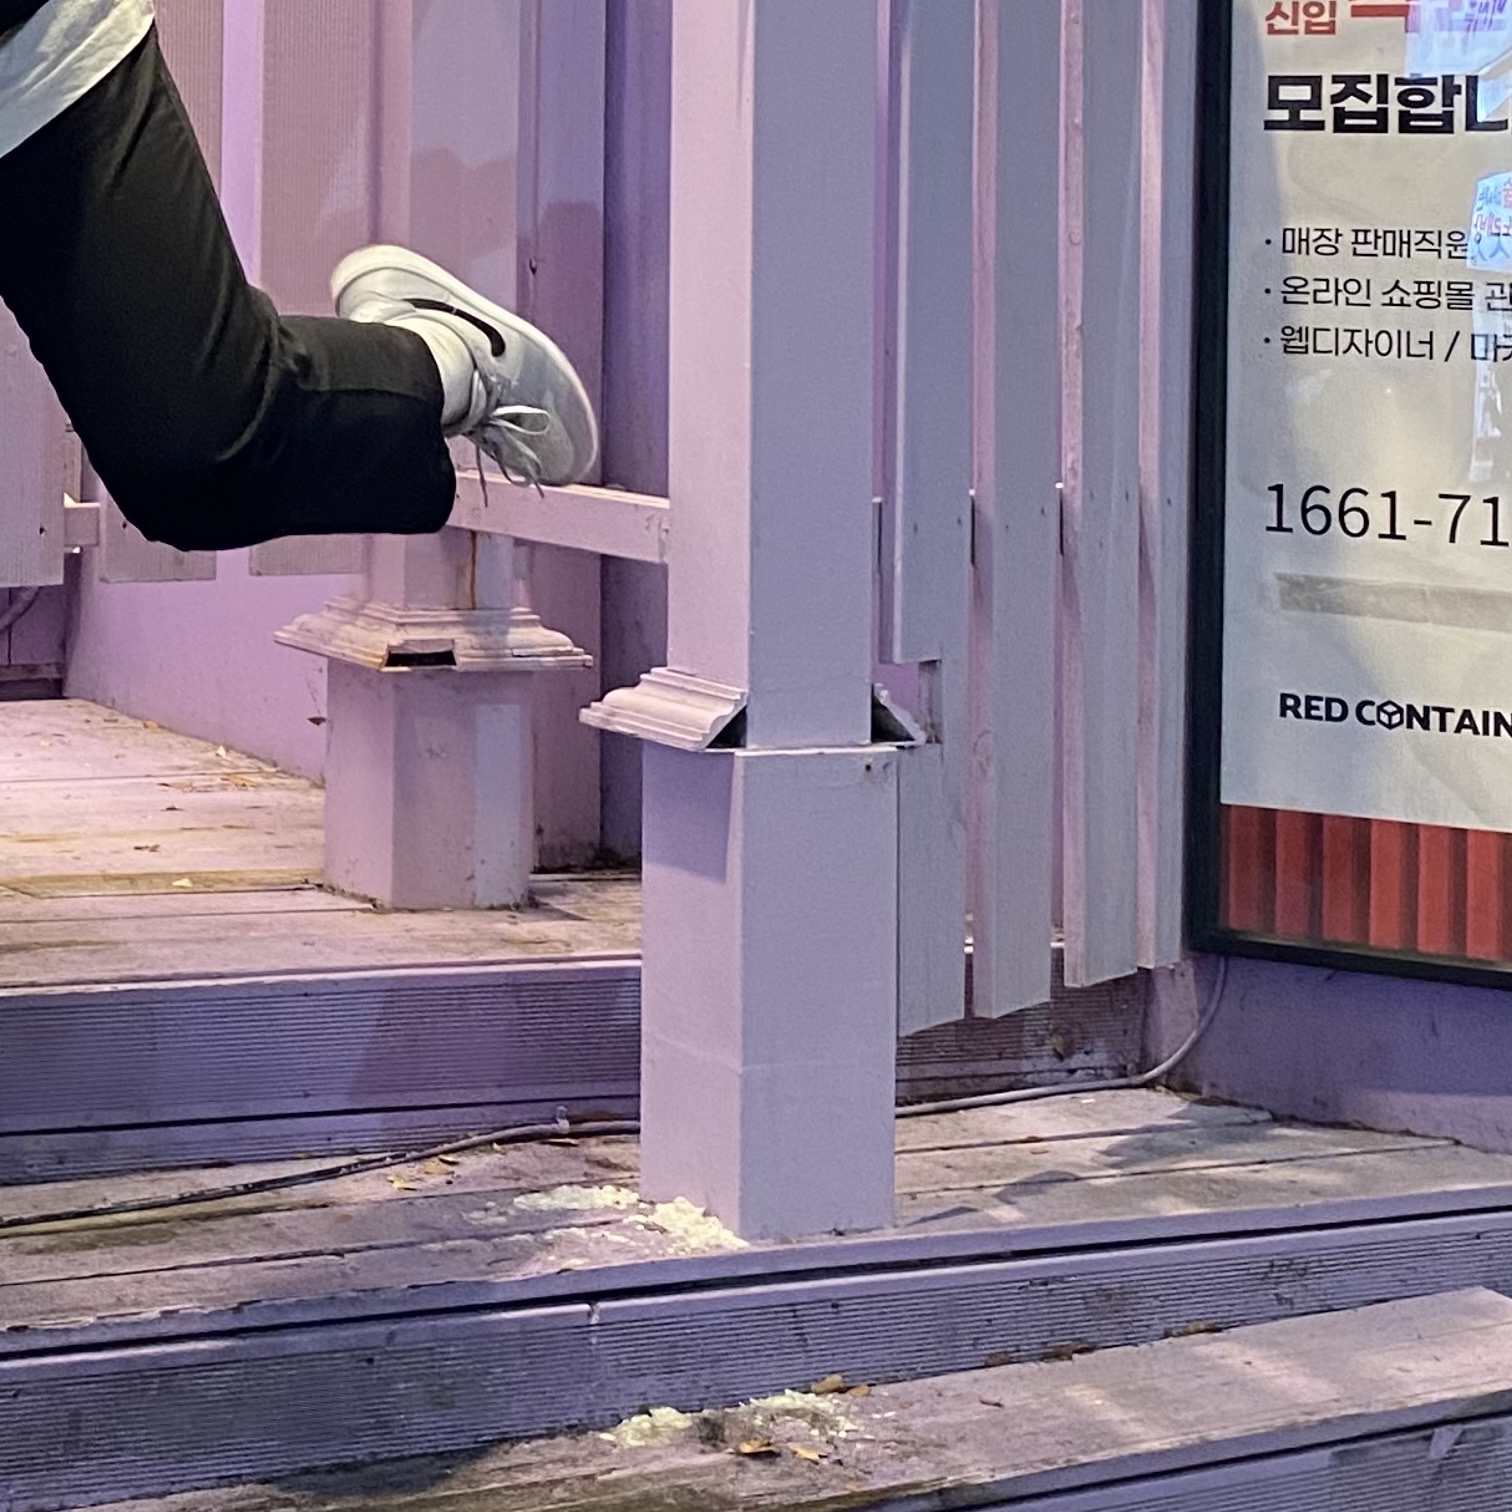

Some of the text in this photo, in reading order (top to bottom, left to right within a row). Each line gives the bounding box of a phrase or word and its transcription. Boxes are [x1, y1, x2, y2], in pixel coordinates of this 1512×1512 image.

[1265, 0, 1337, 36] 신입
[1281, 227, 1470, 260] 매장 판매직원
[1280, 276, 1372, 307] 온라인
[1381, 279, 1475, 311] 쇼핑몰
[1279, 325, 1434, 361] 웹디자이너
[1264, 482, 1510, 548] 1661-71
[1278, 692, 1350, 723] RED
